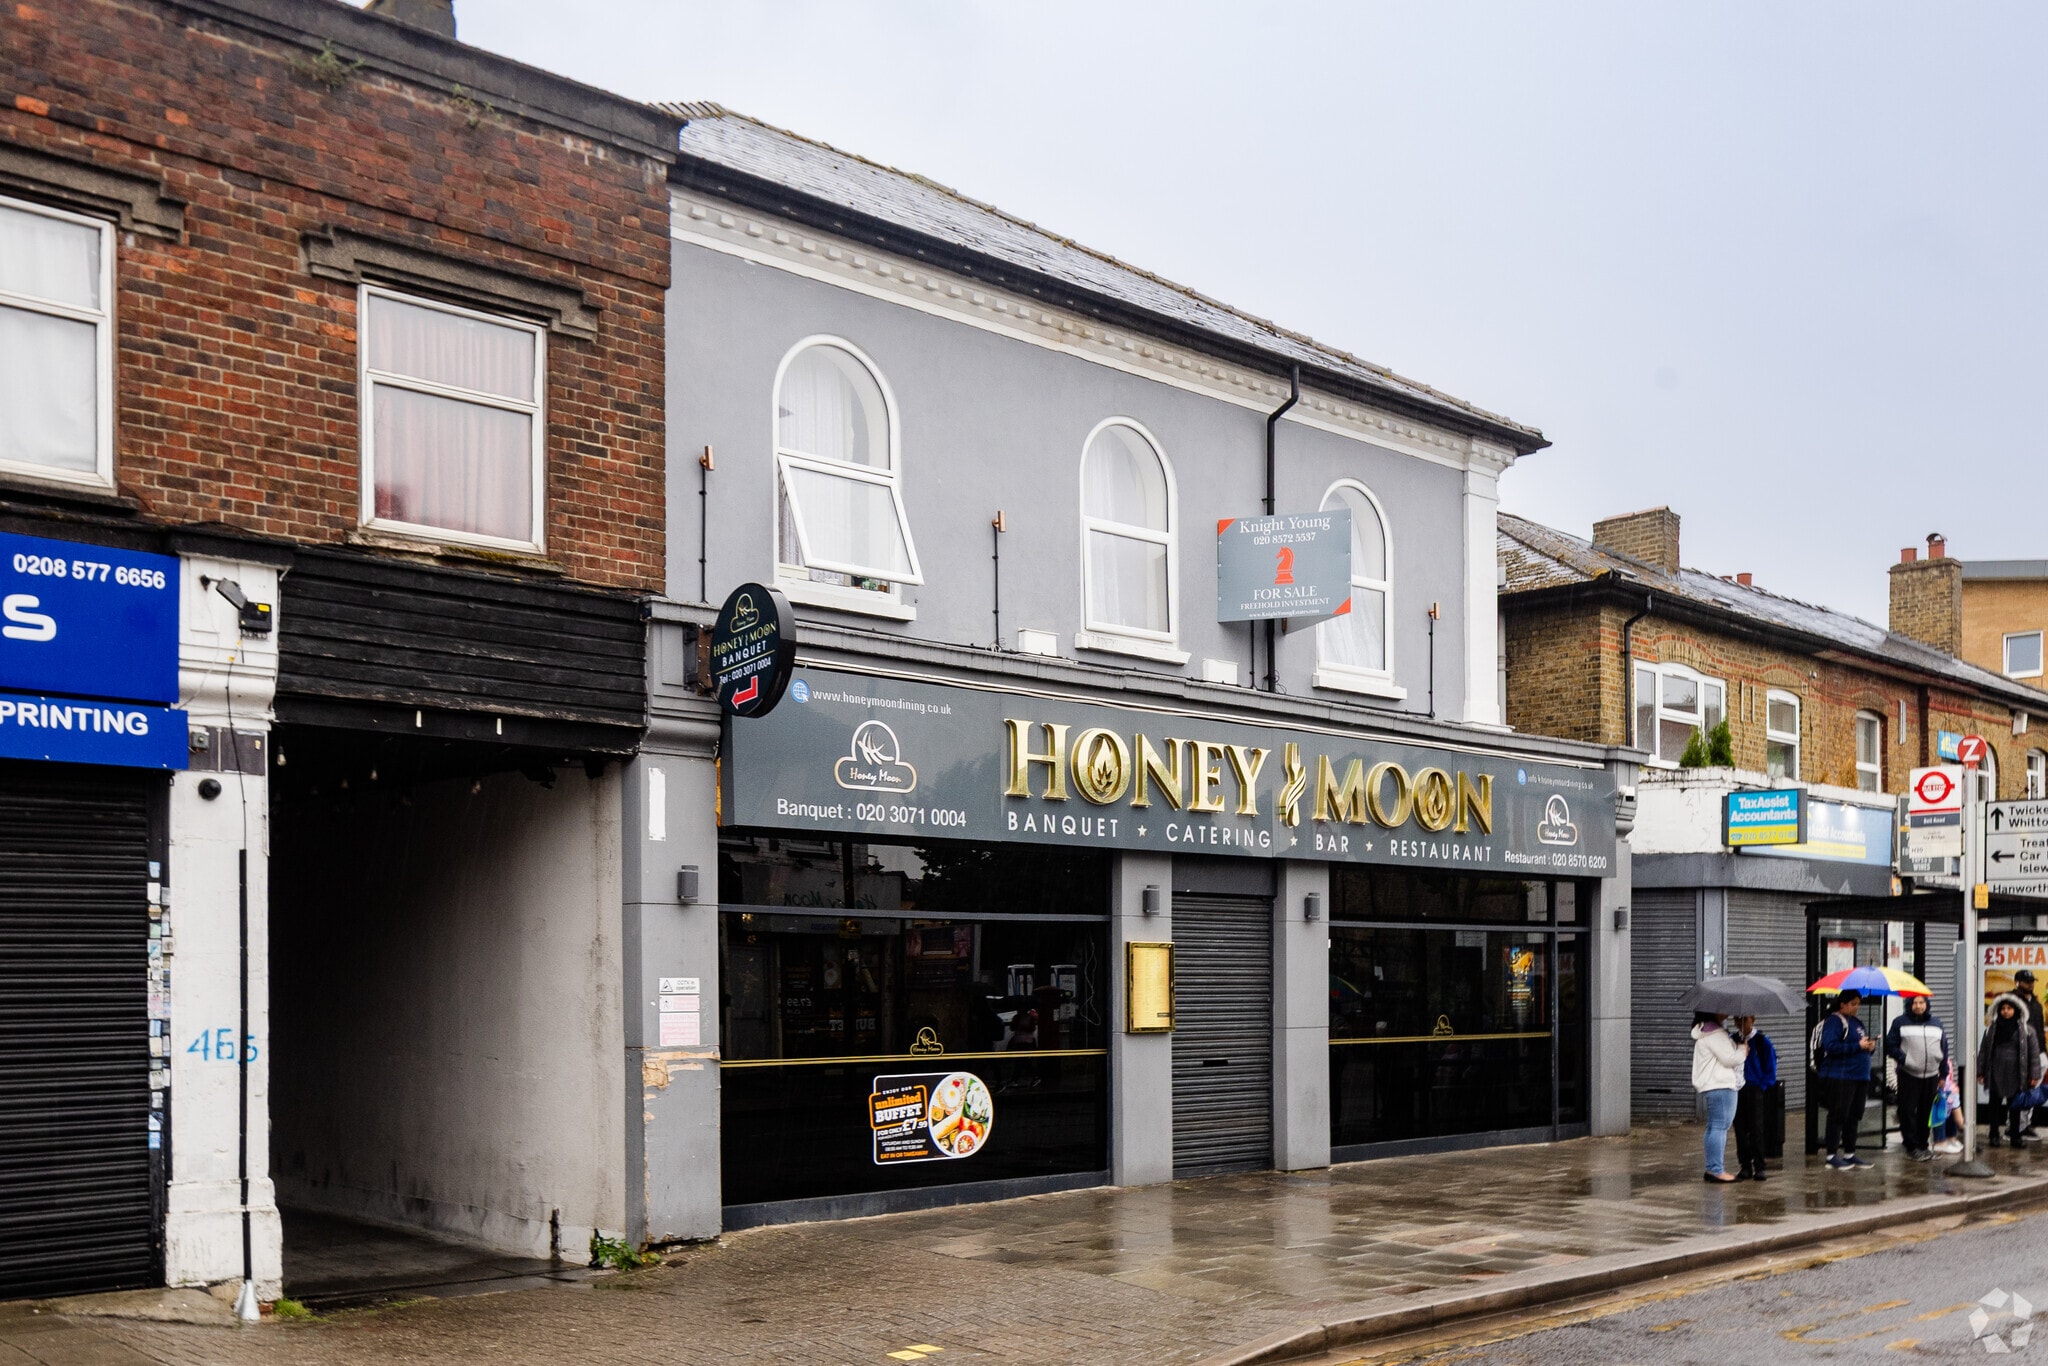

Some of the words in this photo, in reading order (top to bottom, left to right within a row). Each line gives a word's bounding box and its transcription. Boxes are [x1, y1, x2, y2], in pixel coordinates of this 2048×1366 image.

[1240, 518, 1284, 535] Knight
[1288, 517, 1331, 531] Young
[1253, 536, 1270, 545] 020
[1272, 533, 1294, 544] 8572
[1295, 532, 1316, 542] 5537
[13, 553, 67, 577] 0208
[72, 560, 111, 582] 577
[115, 566, 166, 590] 6656
[1253, 587, 1281, 600] FOR
[1284, 585, 1317, 598] SALE
[1240, 600, 1280, 610] FREEHOLD
[1281, 597, 1329, 608] INVESTMENT
[2, 593, 57, 642] S
[714, 635, 743, 657] HONEY
[750, 620, 777, 642] MOON
[722, 640, 766, 667] BANQUET
[719, 674, 728, 684] Tel
[732, 669, 743, 680] 020
[743, 663, 757, 676] 3071
[757, 657, 771, 669] 0004
[812, 689, 952, 715] www.honeymoondining.co.uk
[0, 701, 149, 735] PRINTING
[1960, 739, 1980, 762] Z
[850, 767, 877, 785] Honey
[878, 768, 903, 784] Moon
[1003, 718, 1272, 817] HONEY
[1312, 754, 1496, 835] MOON
[1738, 795, 1789, 809] TaxAssist
[2009, 804, 2048, 816] Twicke
[777, 798, 843, 821] Banquet
[856, 803, 885, 822] 020
[890, 805, 925, 824] 3071
[931, 808, 966, 827] 0004
[1730, 808, 1797, 823] Accountants
[1008, 811, 1118, 838] BANQUET
[1166, 823, 1271, 848] CATERING
[1316, 834, 1349, 853] BAR
[1390, 839, 1492, 862] RESTAURANT
[1744, 831, 1757, 840] 020
[1505, 851, 1546, 866] Restaurant
[1552, 853, 1566, 866] 020
[1568, 854, 1587, 868] 8570
[1588, 855, 1607, 869] 6200
[2020, 850, 2040, 861] Car
[1984, 946, 2005, 965] £5
[2007, 946, 2047, 965] MEA
[875, 1092, 922, 1109] unlimited
[875, 1103, 922, 1122] BUFFET
[902, 1118, 928, 1132] £7.99
